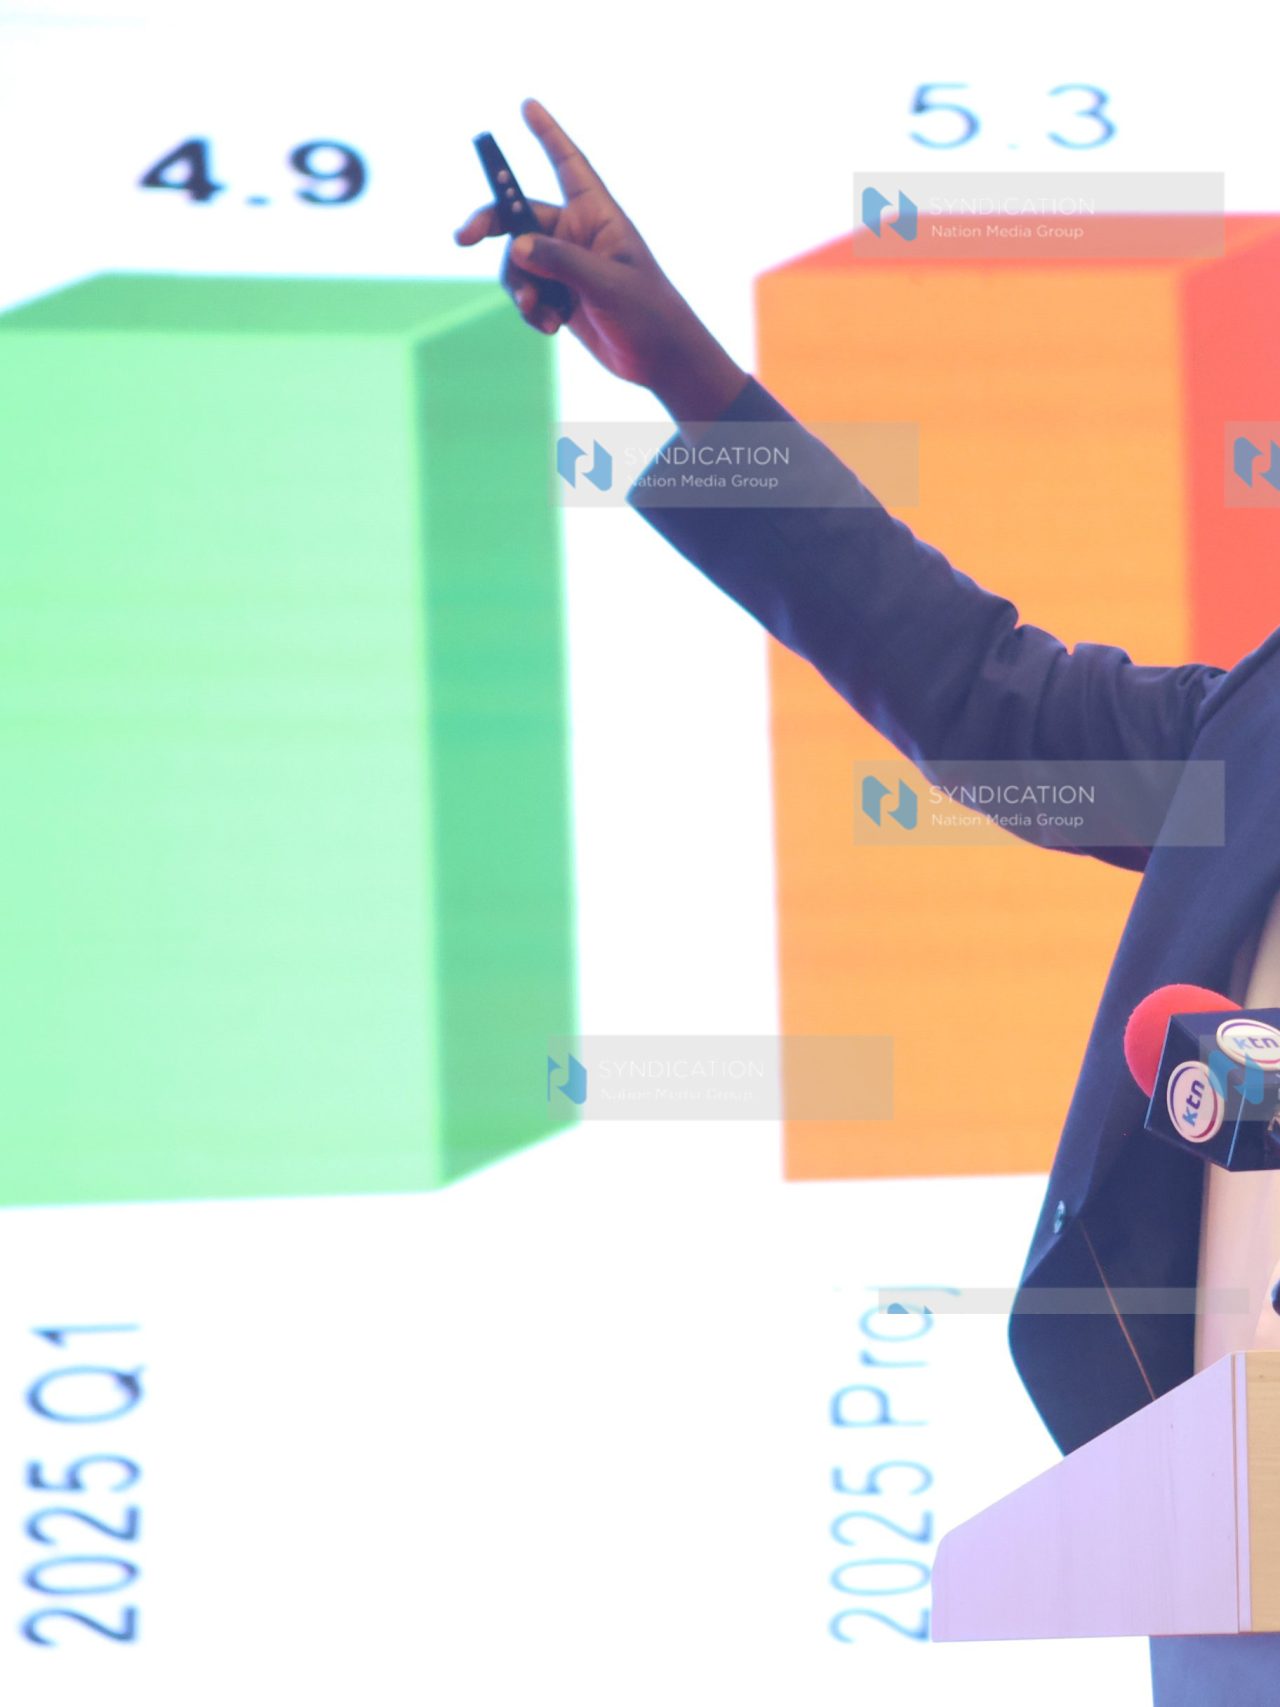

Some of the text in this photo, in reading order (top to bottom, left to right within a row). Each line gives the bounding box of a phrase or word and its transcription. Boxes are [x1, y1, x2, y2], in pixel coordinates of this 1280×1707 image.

[137, 134, 373, 208] 4.9
[908, 82, 1119, 151] 5.3
[19, 1322, 147, 1649] 2025 Q1
[827, 1458, 933, 1645] 2025
